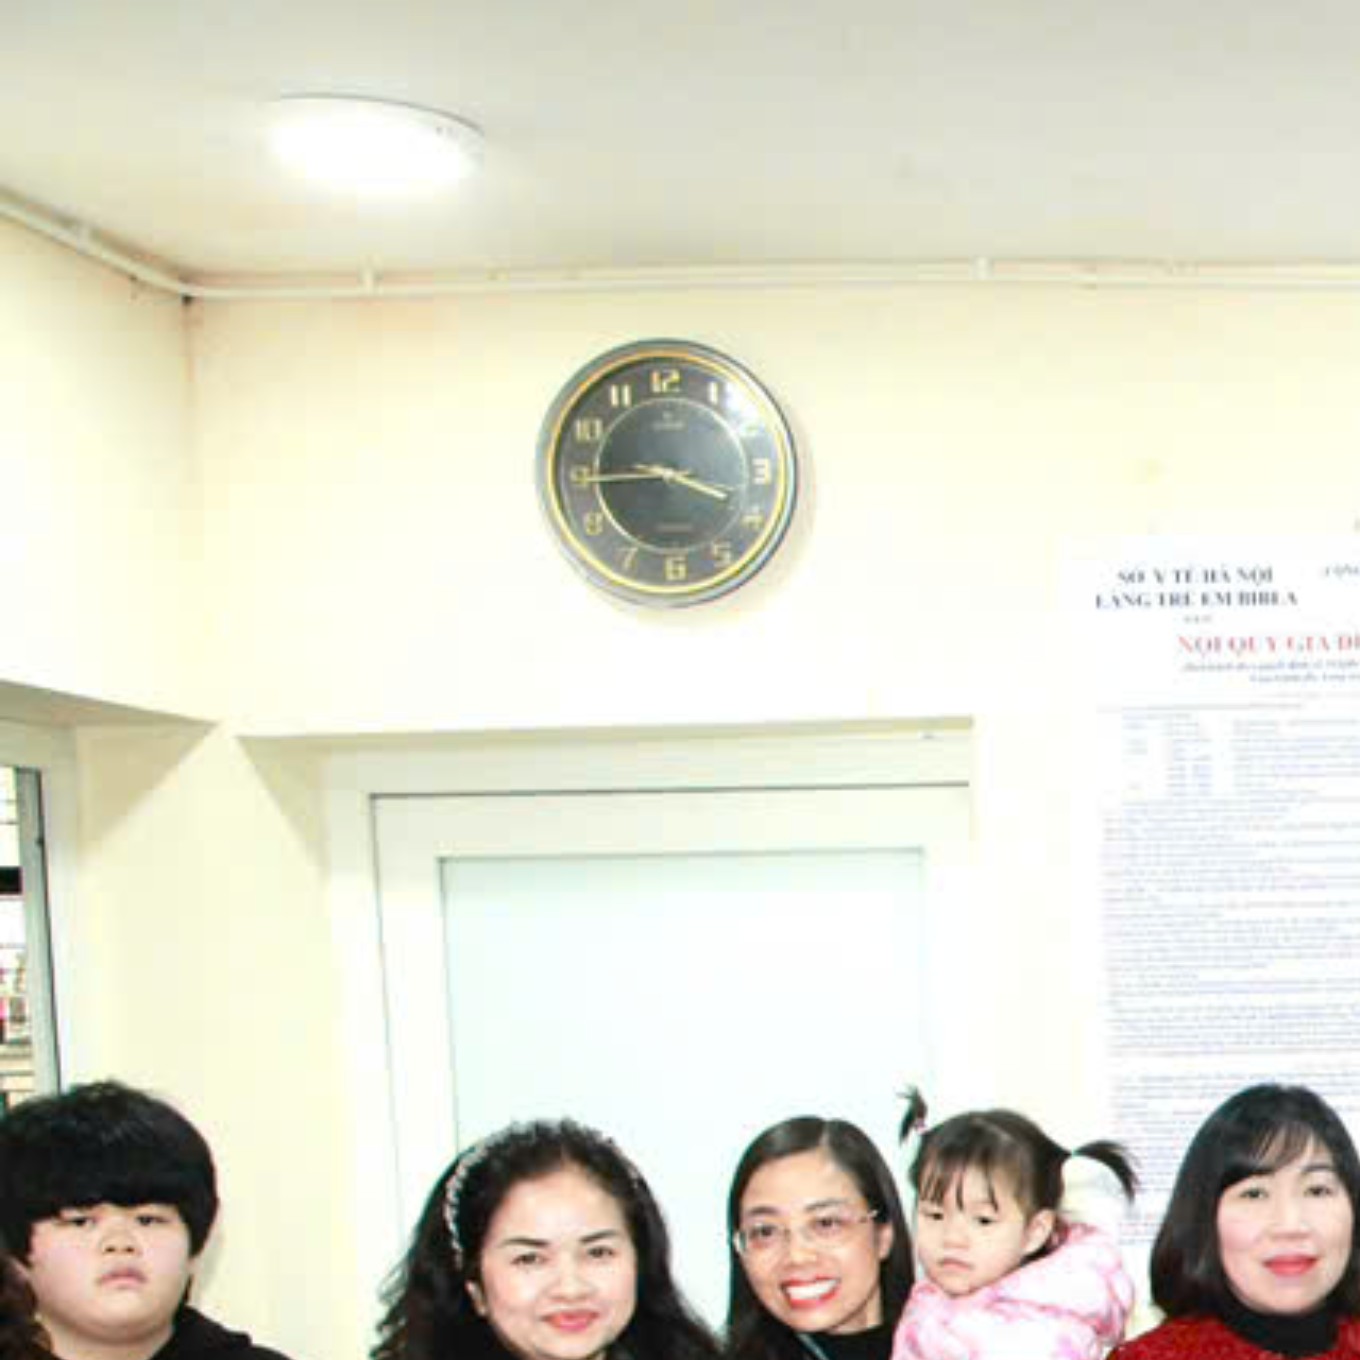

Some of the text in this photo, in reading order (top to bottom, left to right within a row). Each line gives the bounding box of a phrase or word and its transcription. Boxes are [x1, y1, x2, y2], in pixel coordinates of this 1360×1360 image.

[652, 369, 681, 393] 12
[707, 381, 719, 405] 1
[610, 384, 632, 408] 11
[575, 418, 603, 442] 10
[570, 464, 590, 488] 9
[752, 458, 771, 485] 3
[741, 505, 764, 530] 4
[619, 547, 638, 569] 7
[712, 541, 732, 567] 5
[665, 556, 687, 581] 6
[1178, 633, 1222, 657] NỘI
[1227, 633, 1278, 656] QUY
[1285, 632, 1331, 653] GIA
